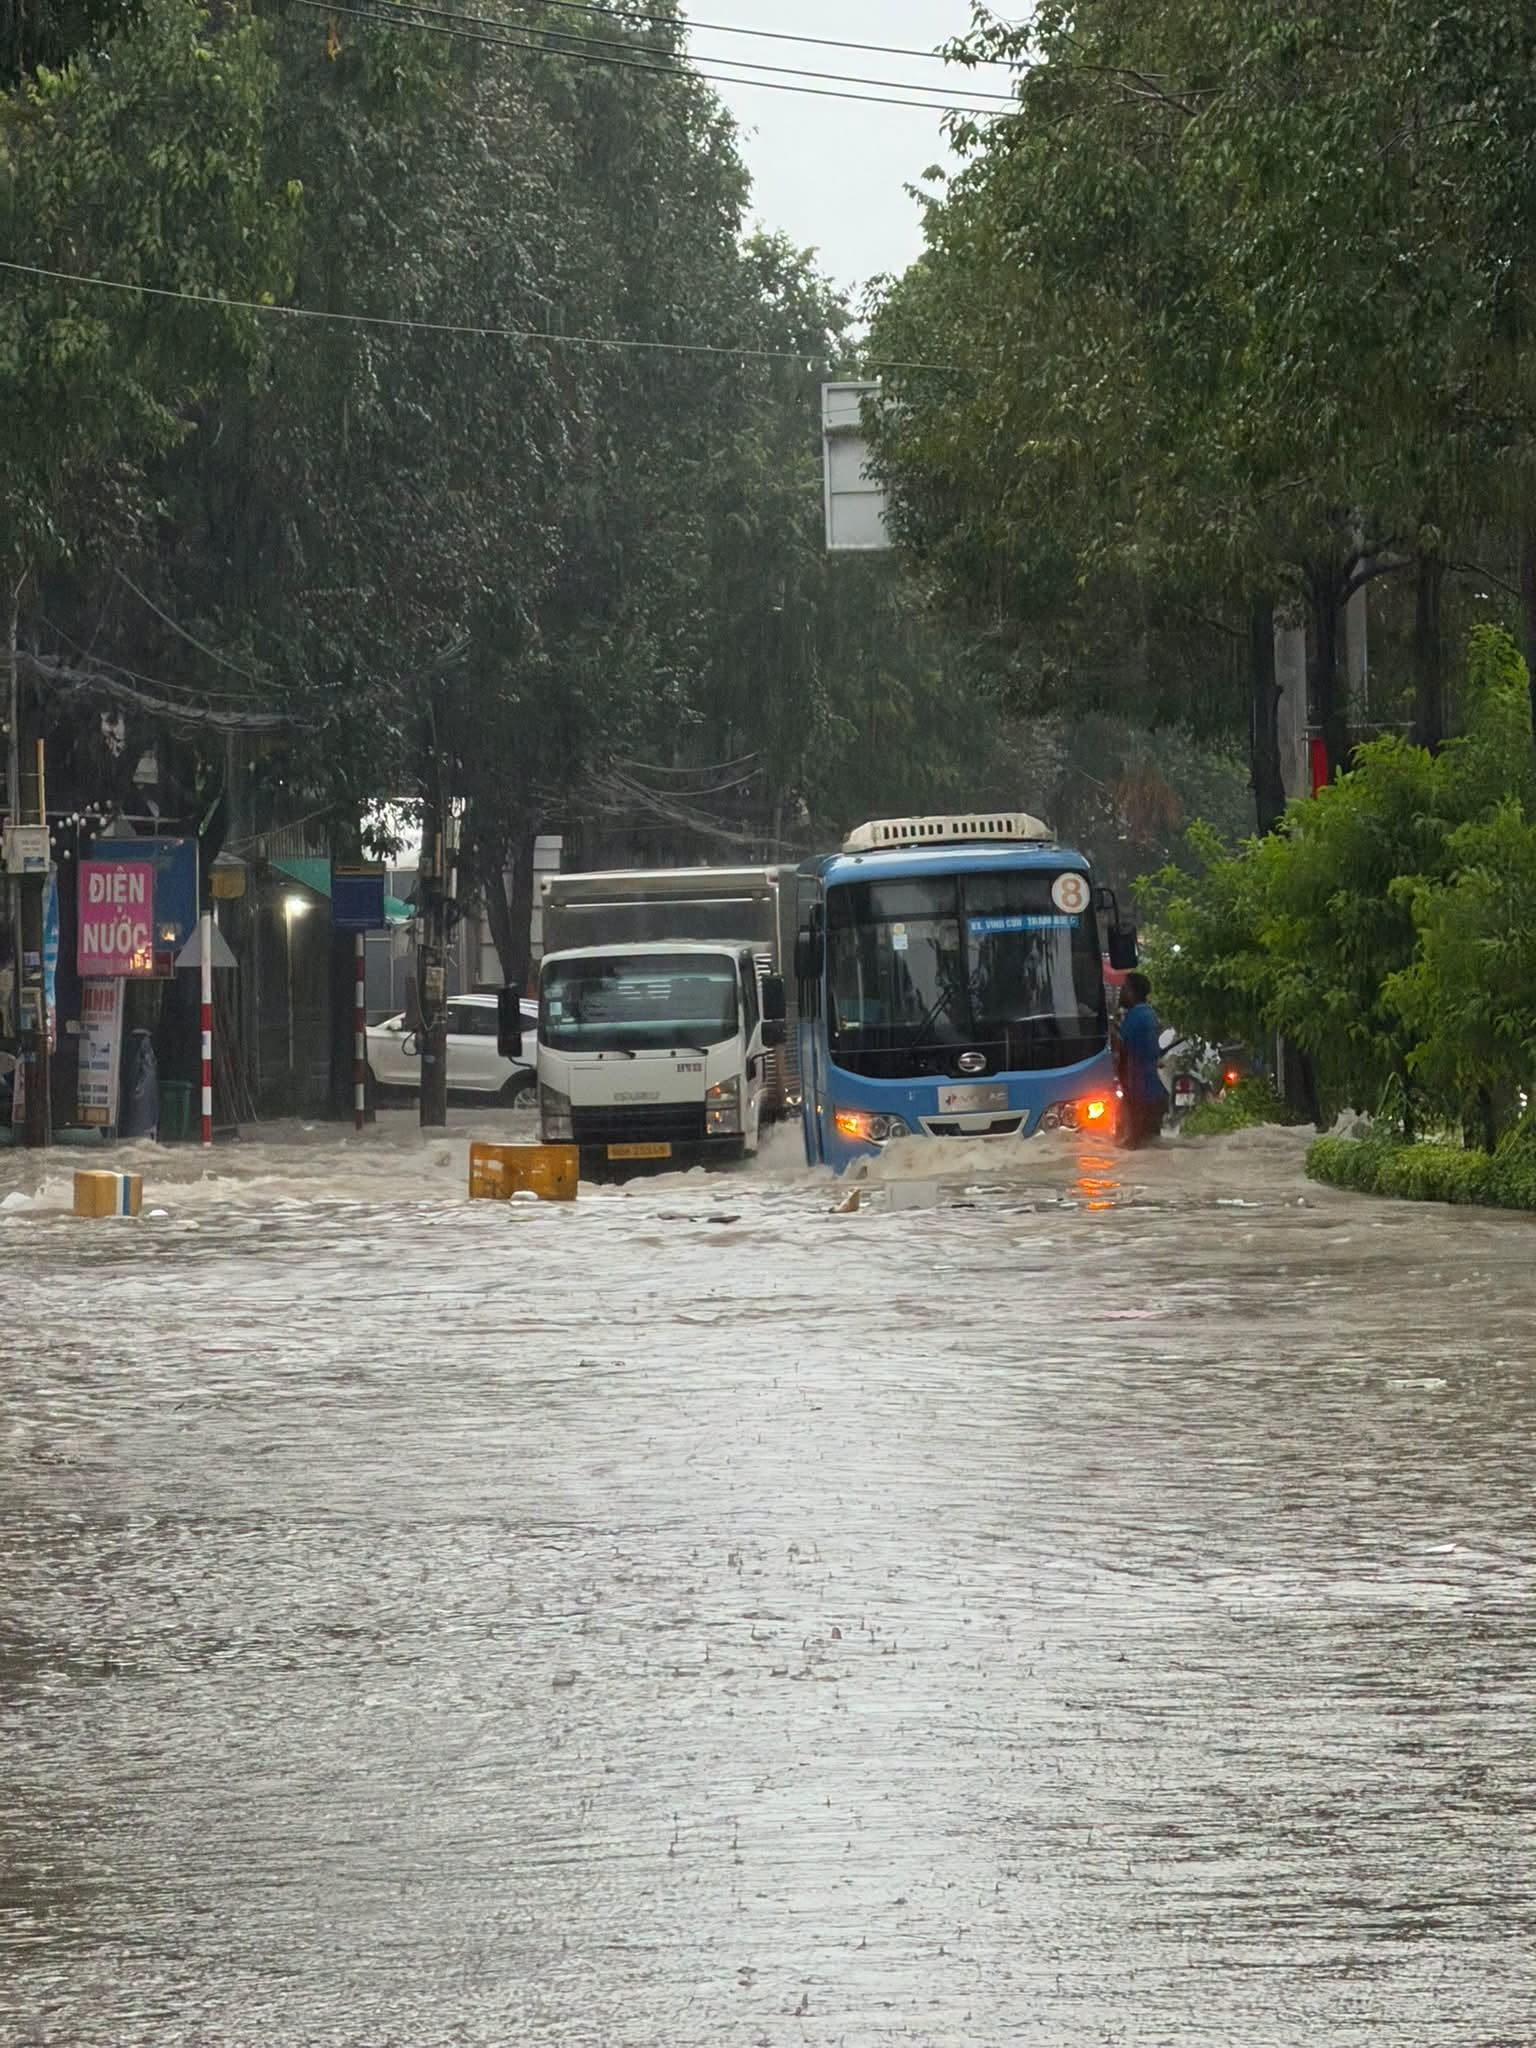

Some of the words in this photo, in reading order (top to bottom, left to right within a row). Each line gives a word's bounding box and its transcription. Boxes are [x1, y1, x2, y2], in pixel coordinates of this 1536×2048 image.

[89, 865, 144, 912] ĐIỆN
[1061, 878, 1082, 908] 8
[83, 914, 148, 954] NƯỚC
